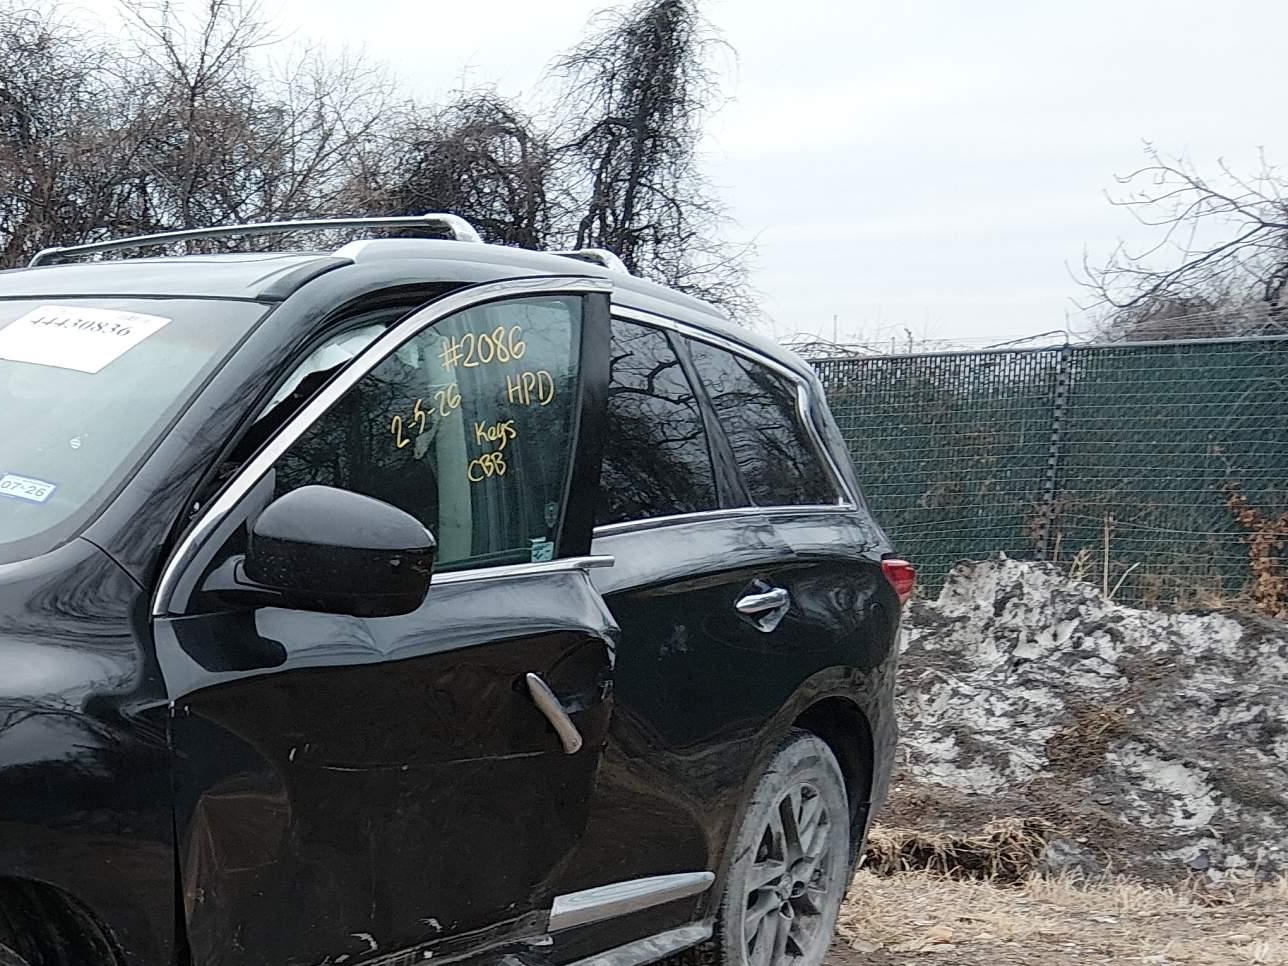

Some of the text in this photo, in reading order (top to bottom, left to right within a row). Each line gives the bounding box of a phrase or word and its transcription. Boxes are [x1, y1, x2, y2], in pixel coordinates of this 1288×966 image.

[438, 325, 527, 372] #2086
[506, 370, 554, 407] HPD
[390, 382, 463, 449] 2-5-26
[474, 419, 518, 450] Keys
[467, 452, 508, 482] CBB
[0, 480, 47, 497] 07-26
